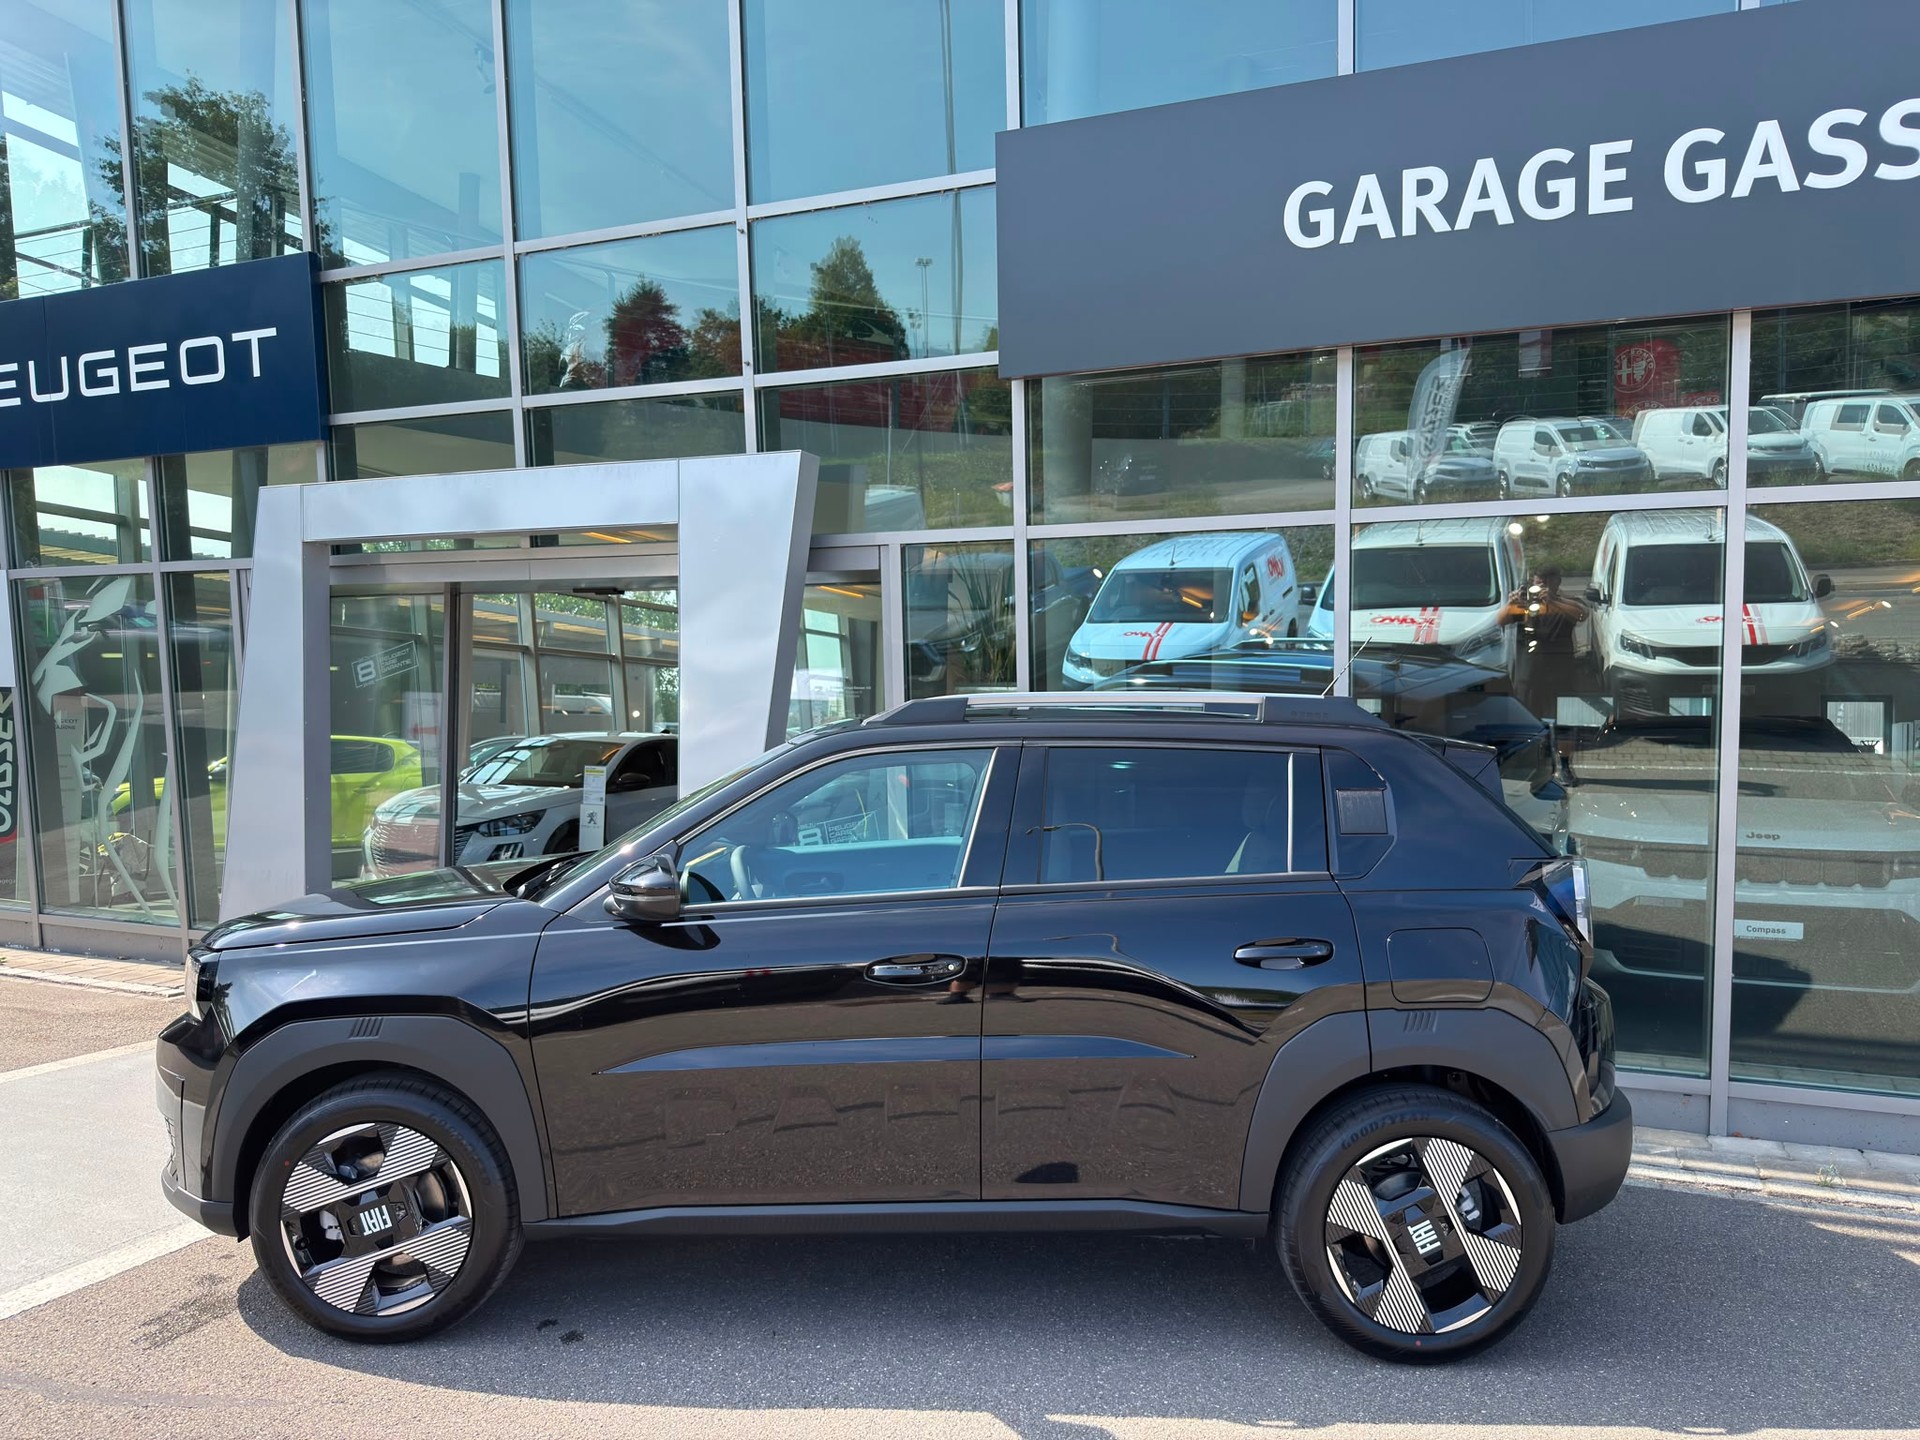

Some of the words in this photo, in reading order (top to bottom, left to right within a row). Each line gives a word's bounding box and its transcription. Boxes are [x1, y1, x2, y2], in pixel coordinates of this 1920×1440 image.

[1282, 138, 1634, 249] GARAGE
[1745, 831, 1781, 841] Jeep
[1746, 925, 1786, 935] Compass
[360, 1204, 393, 1236] FIAT
[1407, 1219, 1441, 1255] FIAT
